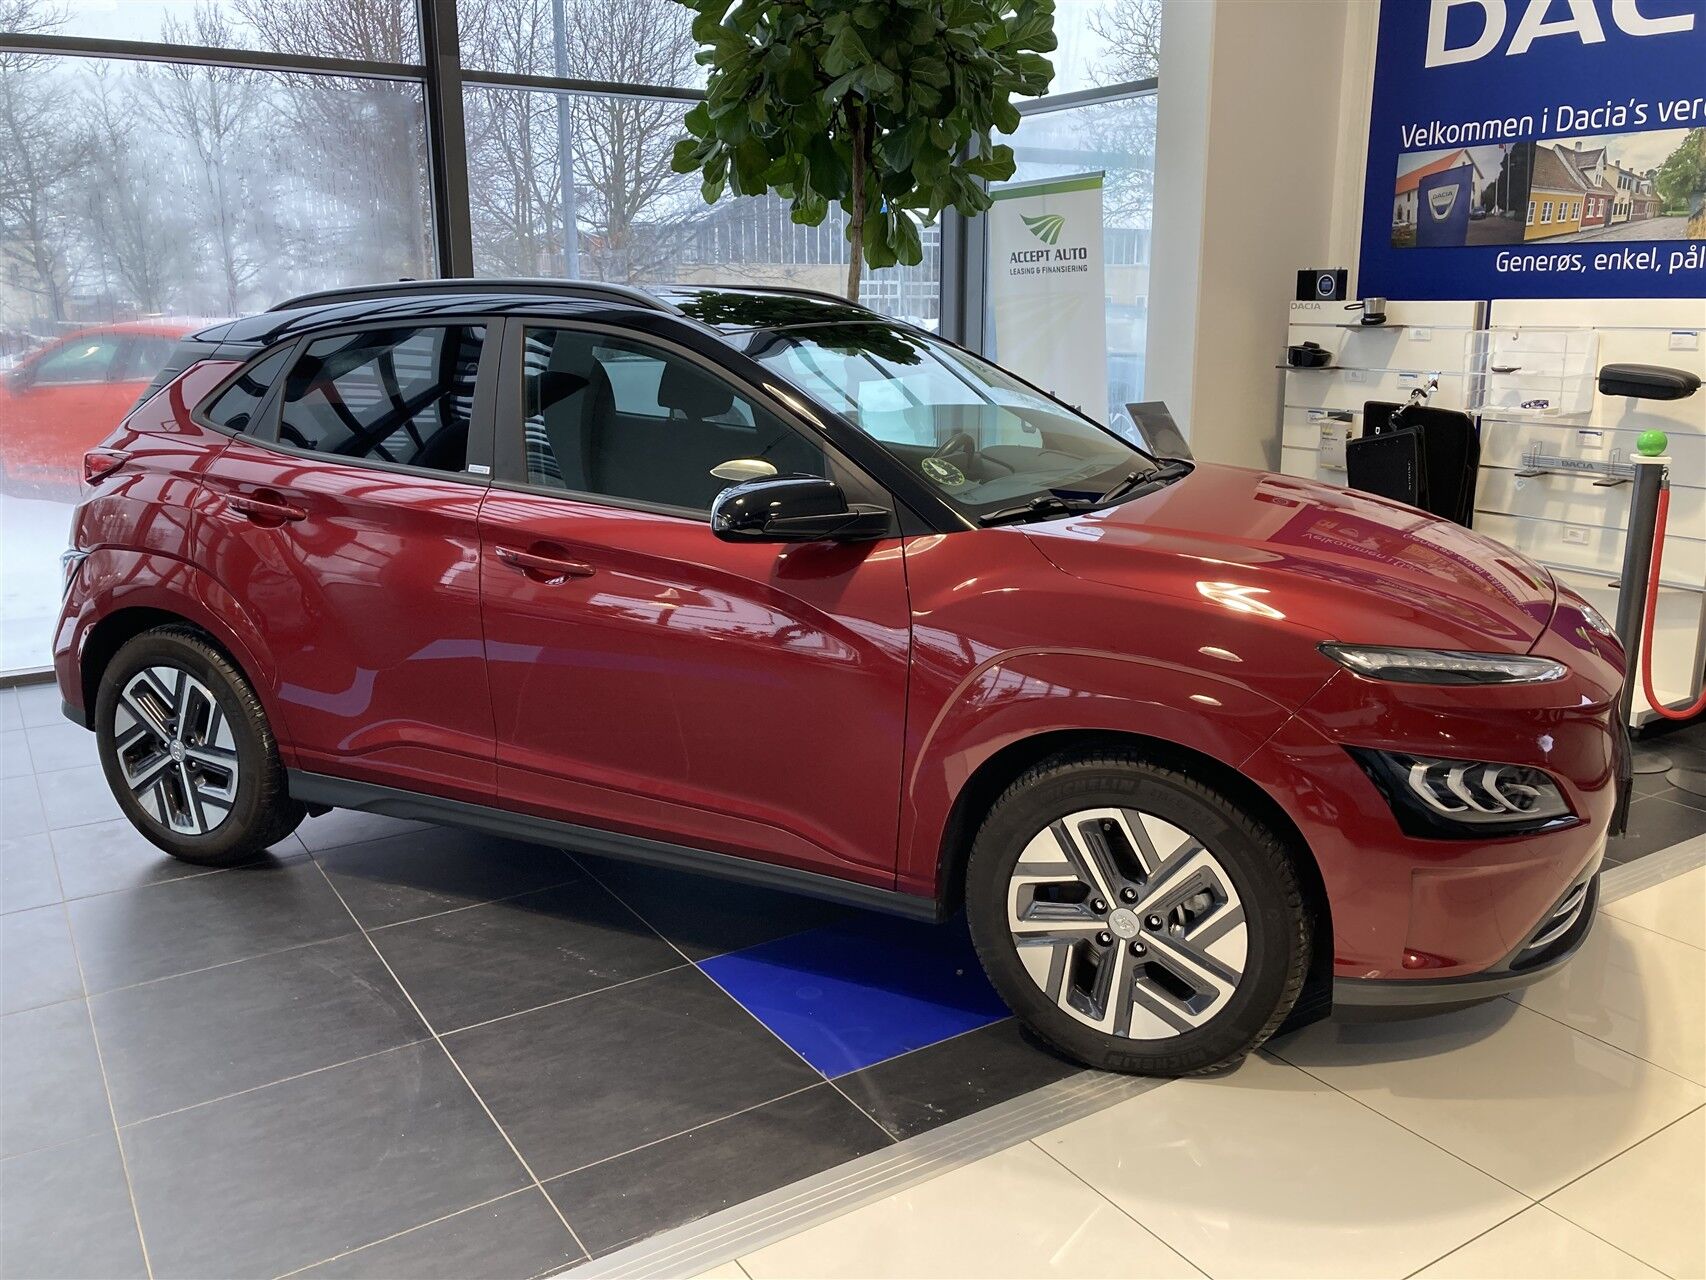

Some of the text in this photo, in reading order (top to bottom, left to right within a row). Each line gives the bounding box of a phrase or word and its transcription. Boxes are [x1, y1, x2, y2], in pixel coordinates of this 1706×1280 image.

[1401, 116, 1534, 148] Velkommen
[1541, 107, 1549, 134] i
[1658, 97, 1706, 122] ver
[1432, 191, 1453, 200] DACIA
[1010, 247, 1087, 263] ACCEPT AUTO
[1496, 244, 1706, 275] Generøs, enkel, pål
[1009, 264, 1088, 276] LEASING & FINANSIERING
[1290, 302, 1322, 310] DACIA
[1561, 460, 1595, 470] DACIA
